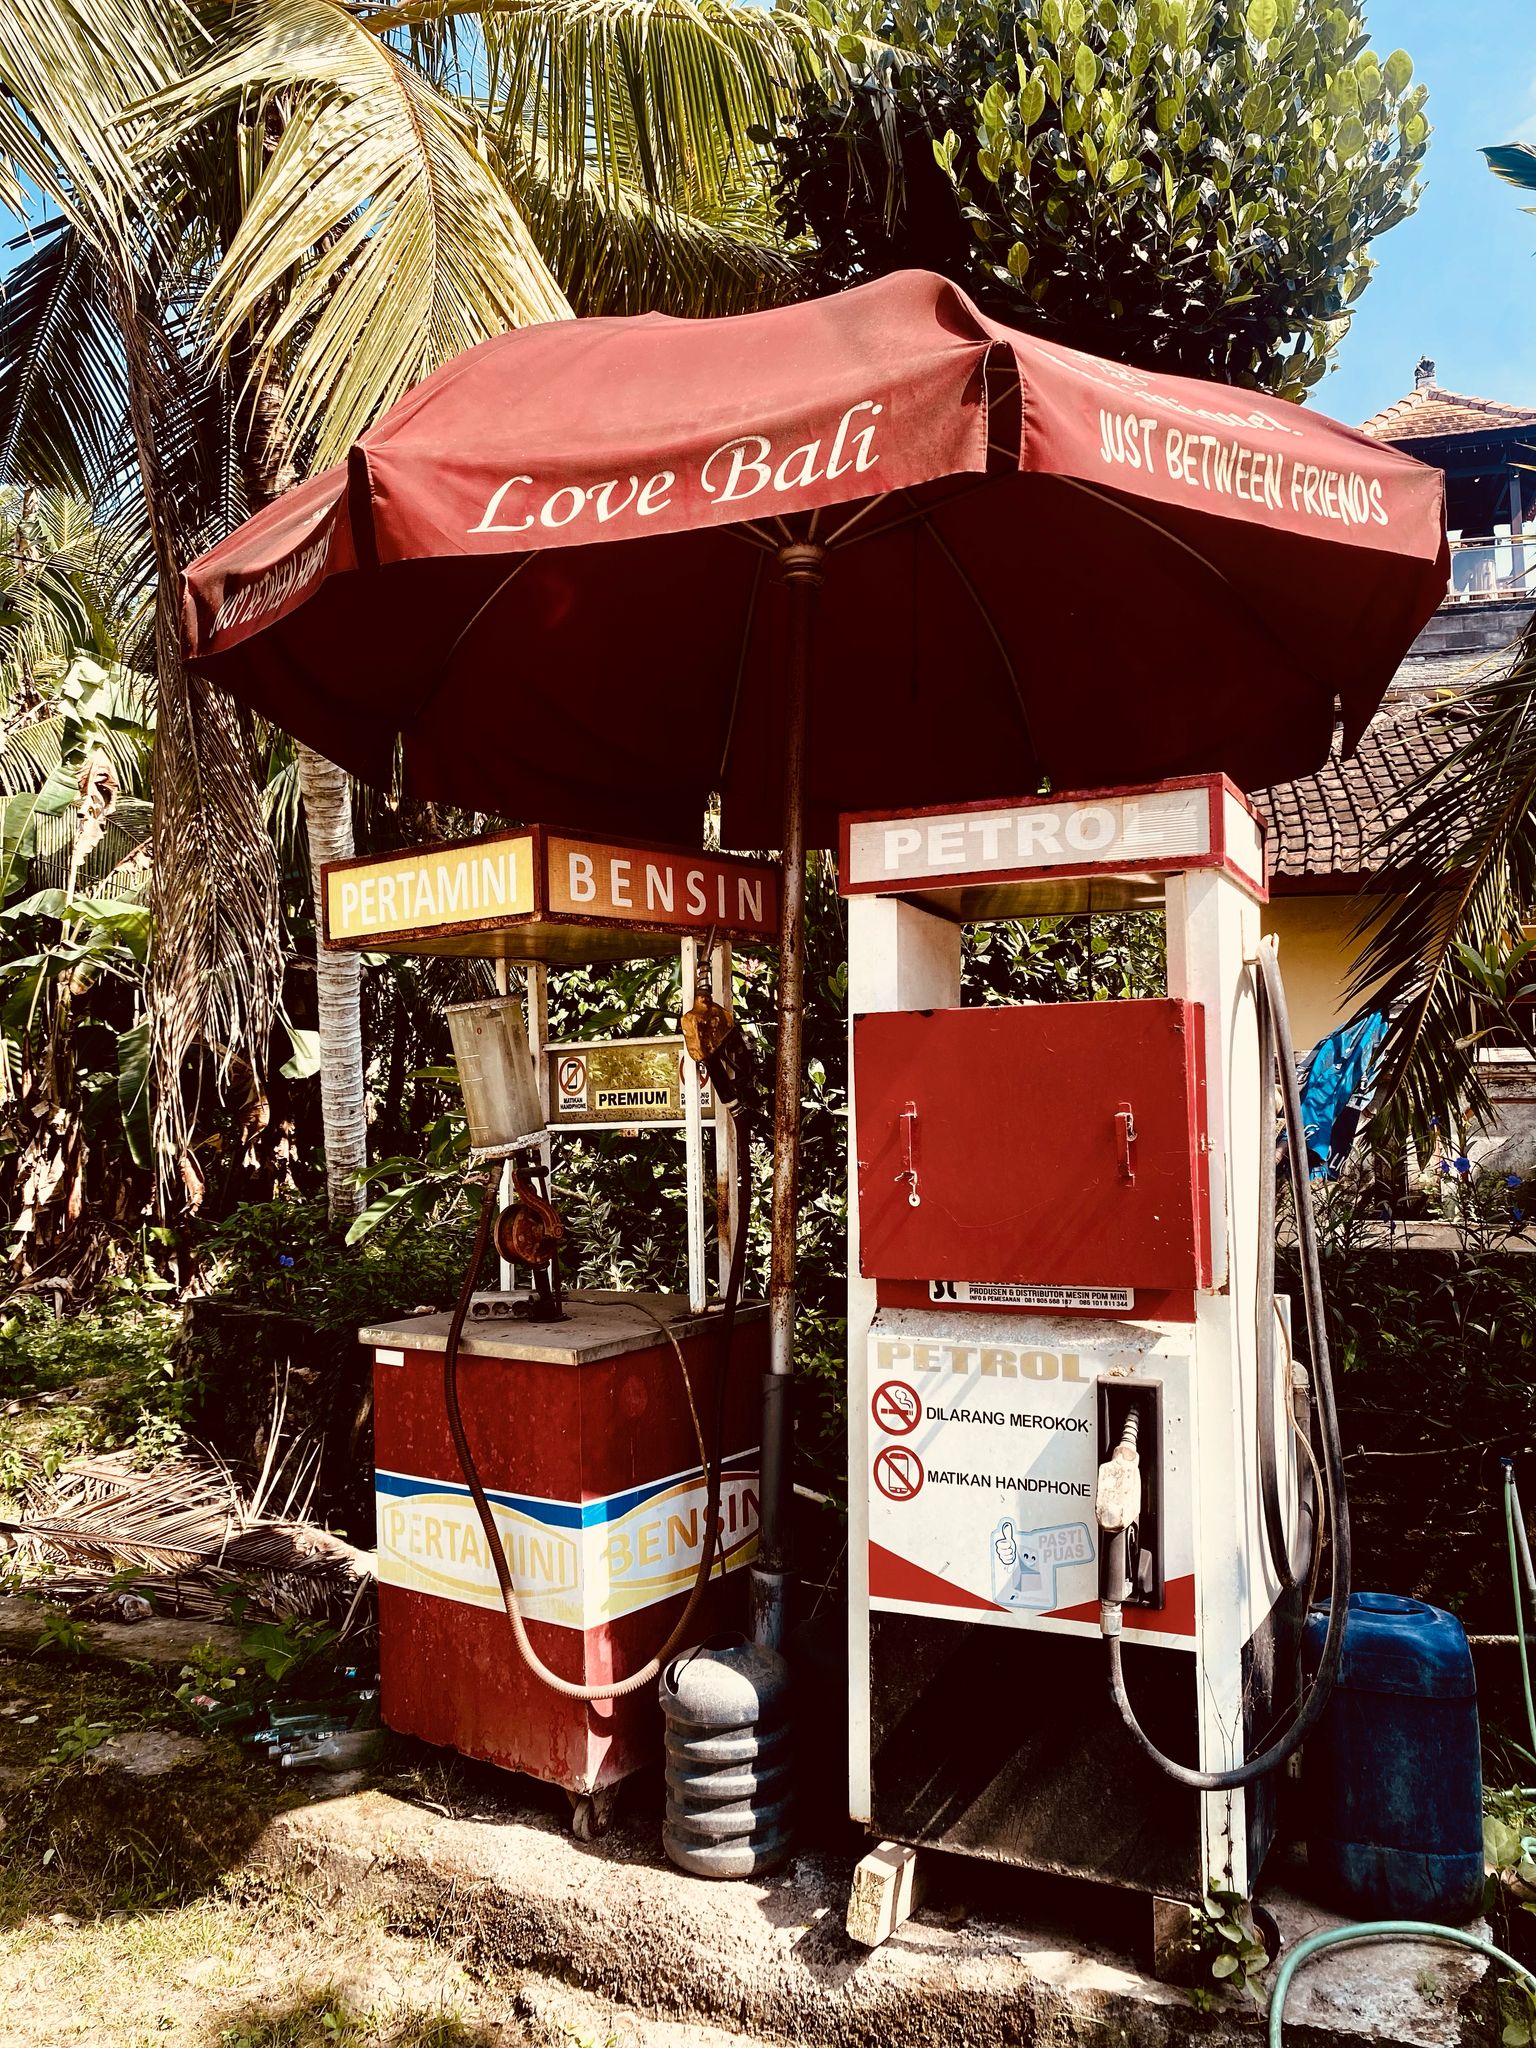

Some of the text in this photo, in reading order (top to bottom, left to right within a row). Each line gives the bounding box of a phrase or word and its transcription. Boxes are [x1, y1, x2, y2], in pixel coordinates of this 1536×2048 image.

[467, 400, 883, 534] Love Bali
[1099, 408, 1389, 527] JUST BETWEEN FRIENDS
[883, 804, 1165, 870] PETROL
[341, 851, 518, 929] PERTAMINI
[568, 852, 762, 923] BENSIN
[598, 1091, 668, 1107] PREMIUM
[969, 1287, 1007, 1296] PRODUSEN
[1016, 1289, 1064, 1298] DISTRIBUTOR
[1065, 1291, 1090, 1300] MESIN
[1091, 1292, 1108, 1300] POM
[1110, 1293, 1128, 1301] MINI
[876, 1341, 1090, 1384] PETROL
[926, 1406, 1089, 1433] DILARANG MEROKOK
[927, 1470, 1091, 1497] MATIKAN HANDPHONE
[1038, 1528, 1082, 1549] PASTI
[1043, 1543, 1085, 1563] PUAS
